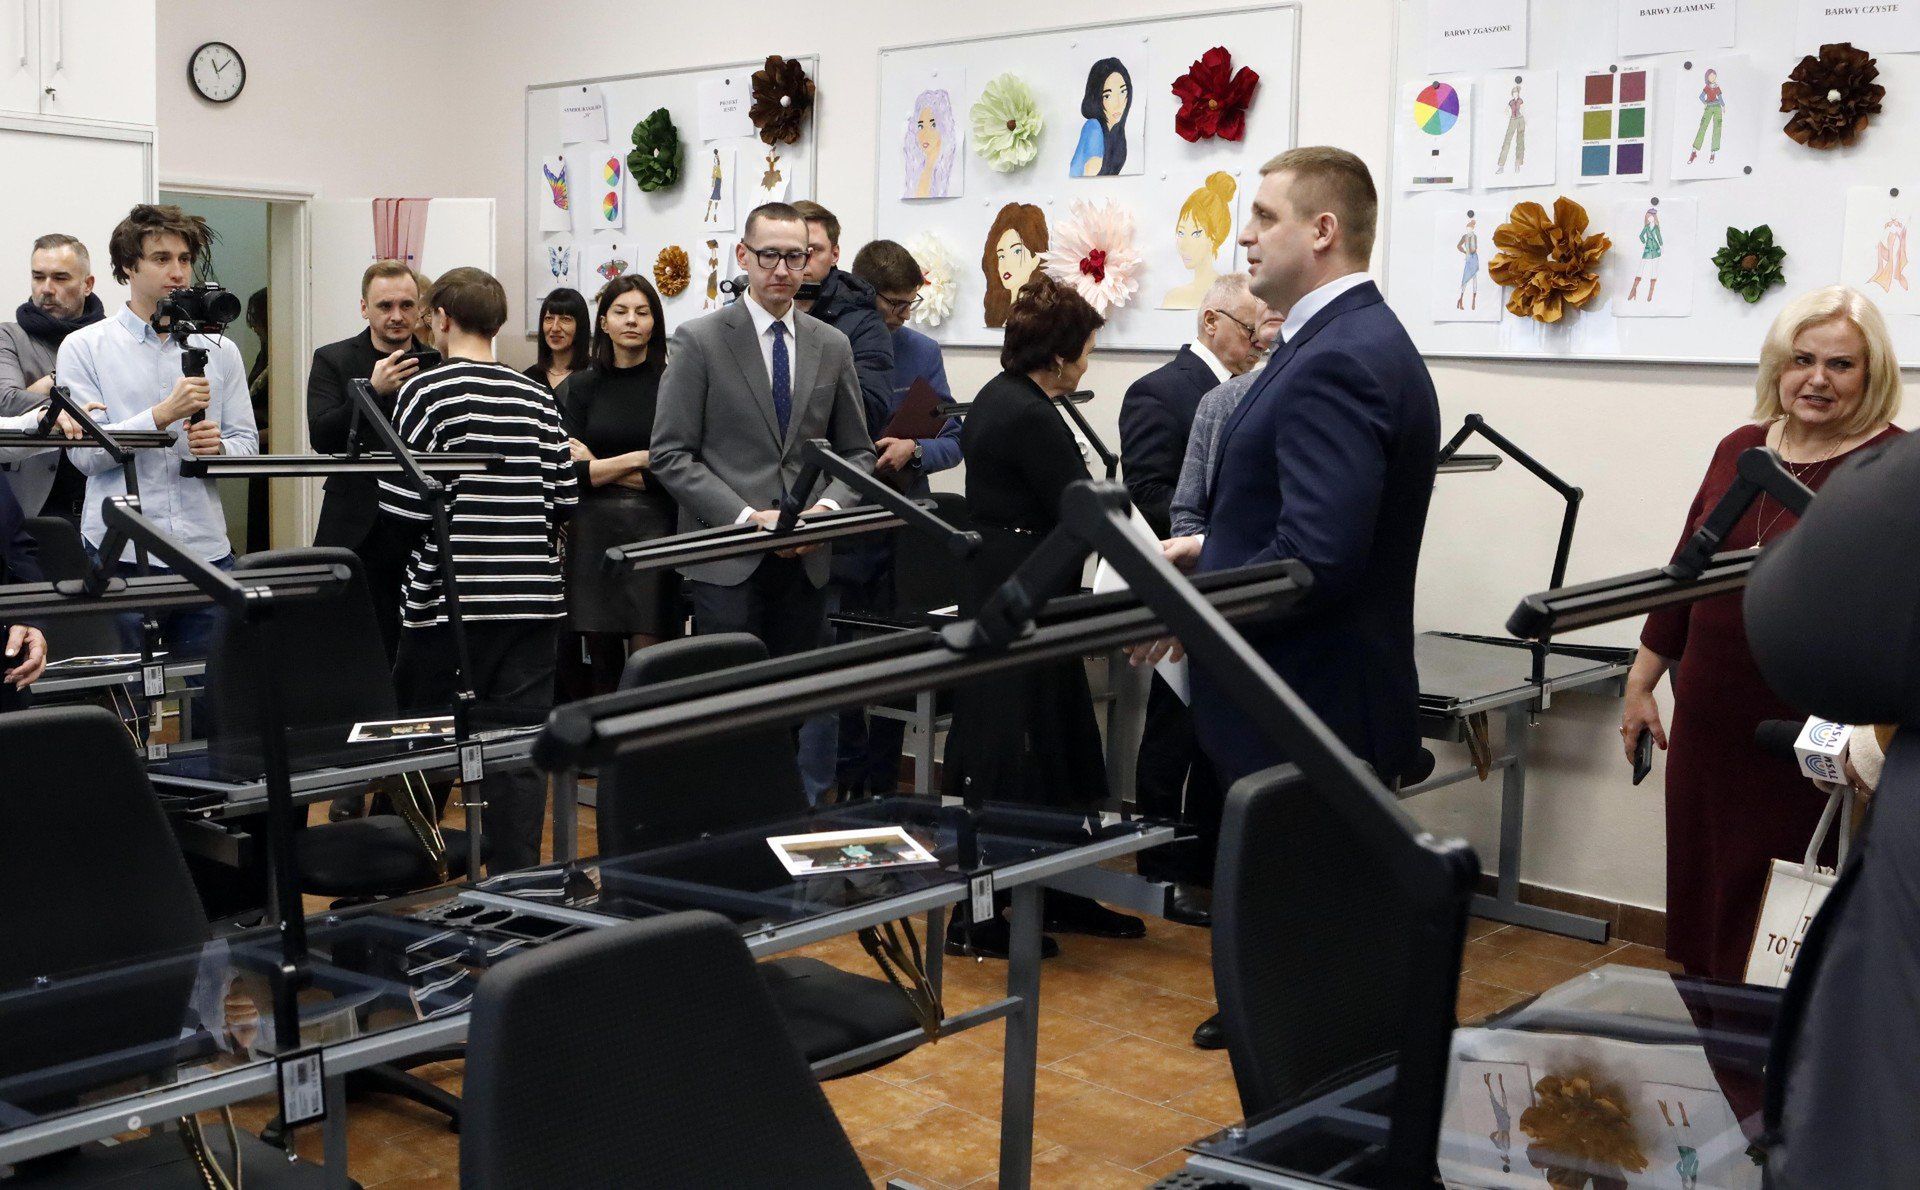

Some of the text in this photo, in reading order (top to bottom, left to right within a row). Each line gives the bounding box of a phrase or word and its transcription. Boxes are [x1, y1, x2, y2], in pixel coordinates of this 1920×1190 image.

[1640, 7, 1671, 16] BARWY
[1825, 4, 1899, 16] BARWY CZYSTE
[1444, 24, 1512, 38] BARWY ZGASZONE
[1766, 932, 1788, 956] TO
